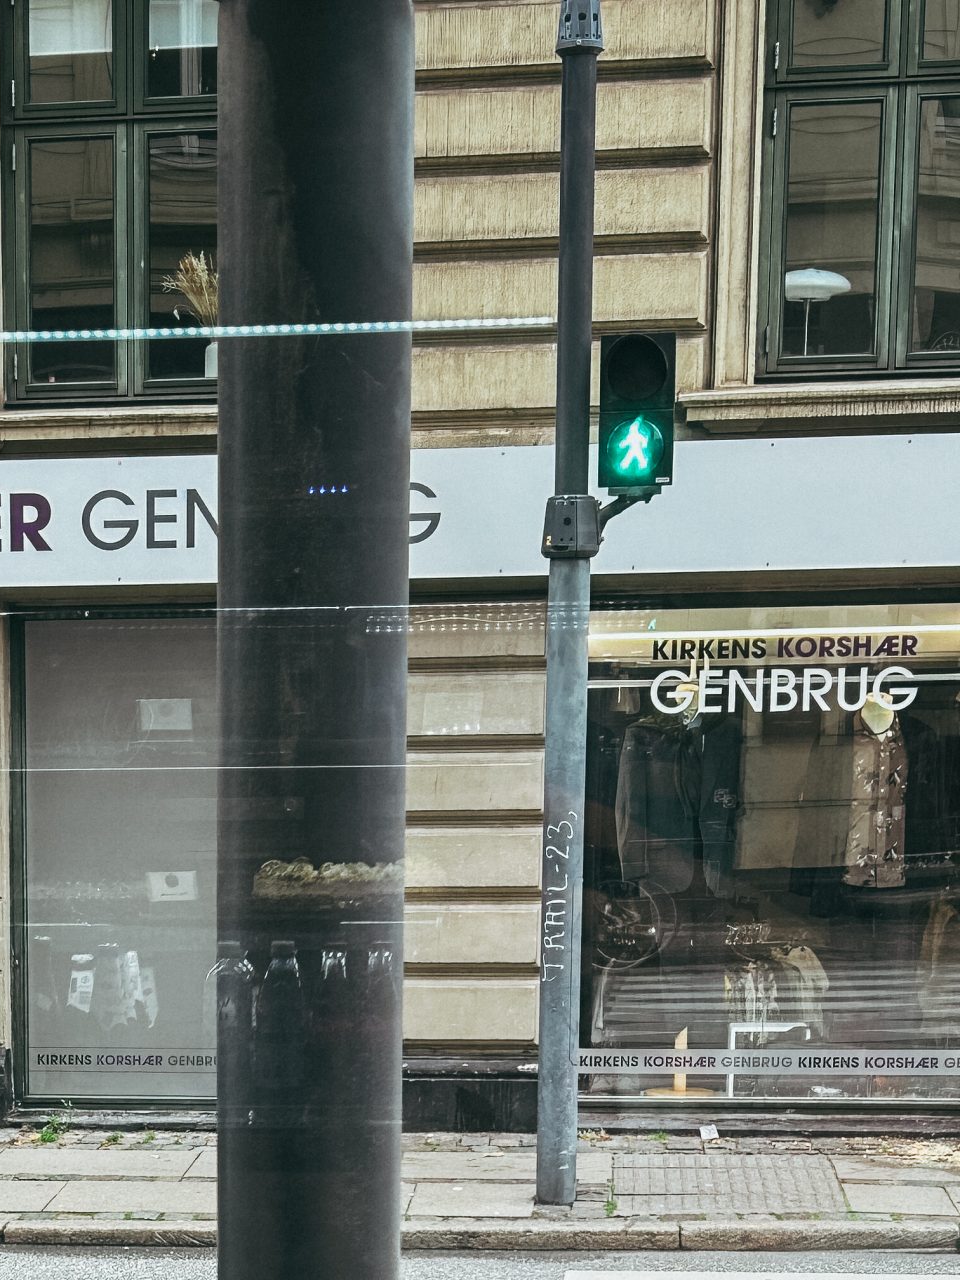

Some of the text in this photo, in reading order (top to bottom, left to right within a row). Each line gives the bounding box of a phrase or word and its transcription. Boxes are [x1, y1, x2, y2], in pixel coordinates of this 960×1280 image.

[82, 483, 442, 551] GENG
[652, 635, 918, 660] KIRKENS KORSHÆR
[650, 666, 919, 714] GENBRUG
[37, 1054, 92, 1066] KIRKENS
[96, 1055, 163, 1066] KORSHÆR
[579, 1055, 639, 1068] KIRKENS
[643, 1056, 716, 1068] KORSHÆR
[721, 1056, 793, 1068] GENBRUG
[798, 1056, 860, 1069] KIRKENS
[864, 1057, 939, 1069] KORSHÆR
